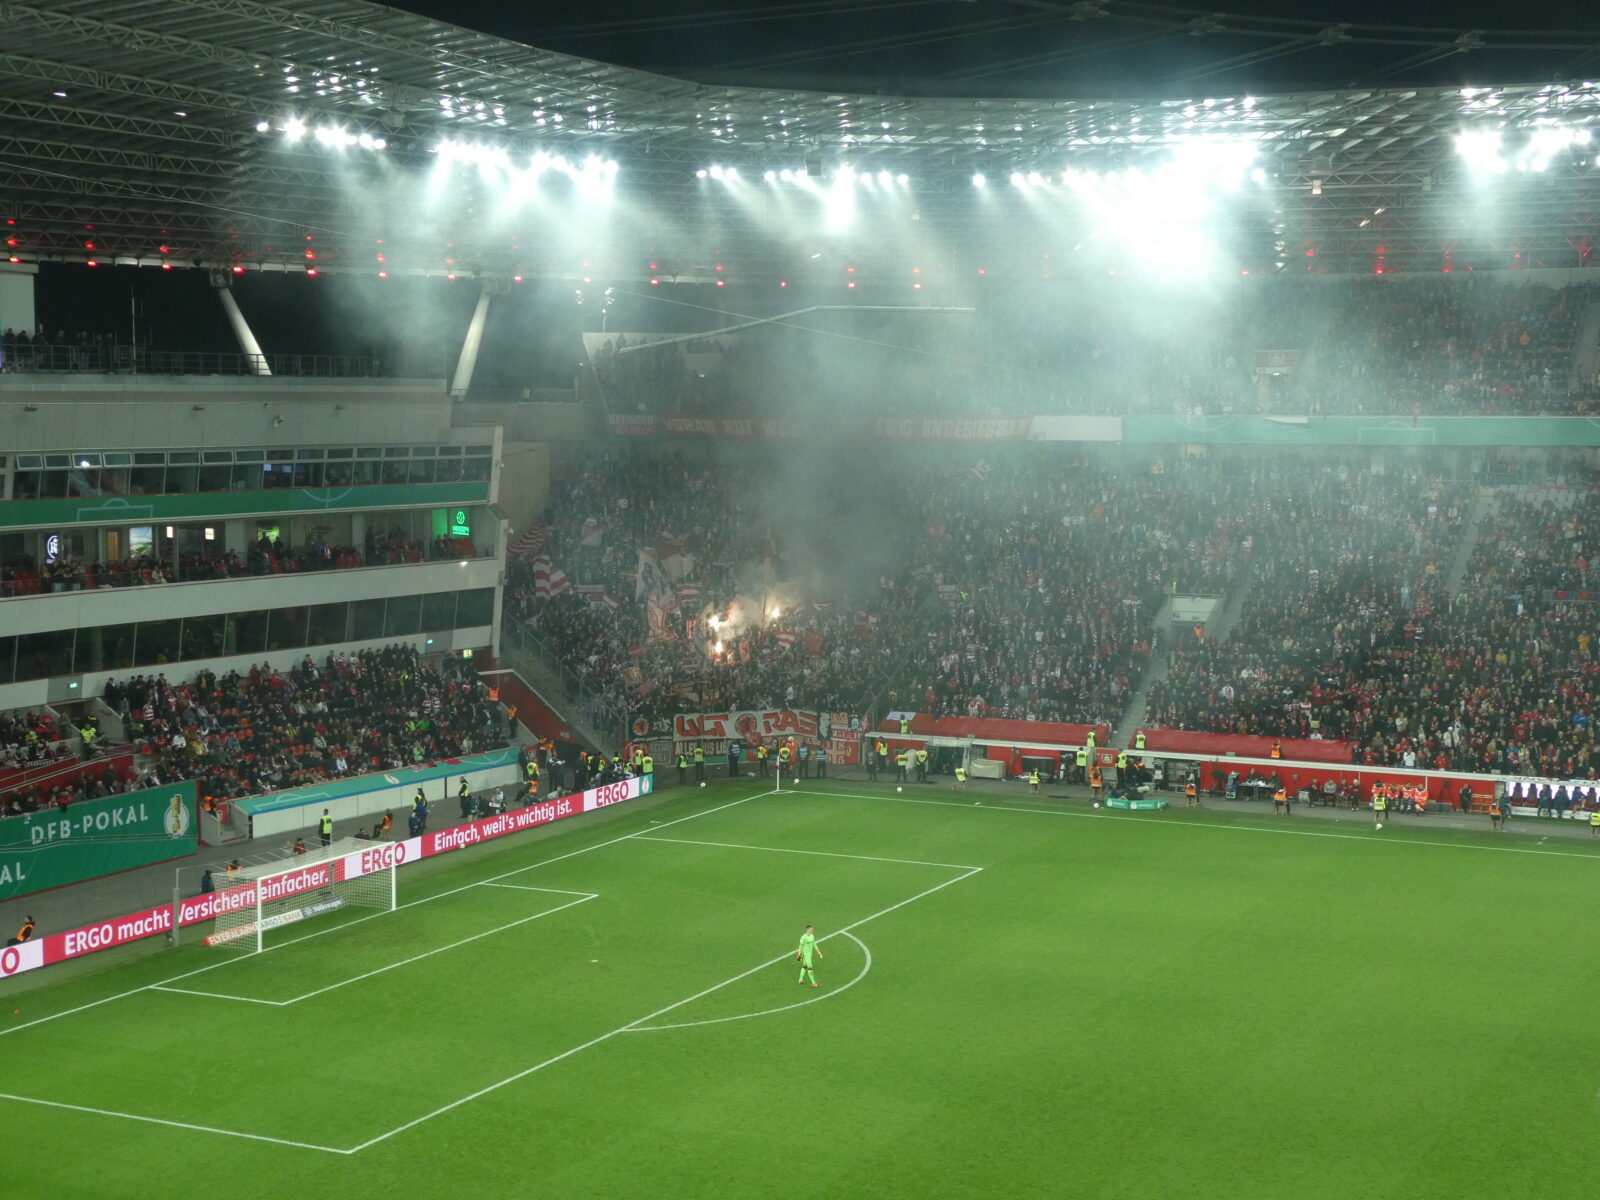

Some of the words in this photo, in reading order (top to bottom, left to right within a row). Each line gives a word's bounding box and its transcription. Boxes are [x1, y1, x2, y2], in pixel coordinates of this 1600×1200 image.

[595, 781, 629, 807] ERGO
[31, 803, 149, 846] DFB-POKAL
[434, 822, 481, 852] Einfach,
[516, 802, 556, 828] wichtig
[557, 799, 573, 815] ist.
[361, 842, 406, 874] ERGO
[64, 924, 113, 956] ERGO
[117, 908, 171, 938] macht
[178, 888, 256, 923] Versichern
[260, 869, 329, 900] einfacher.
